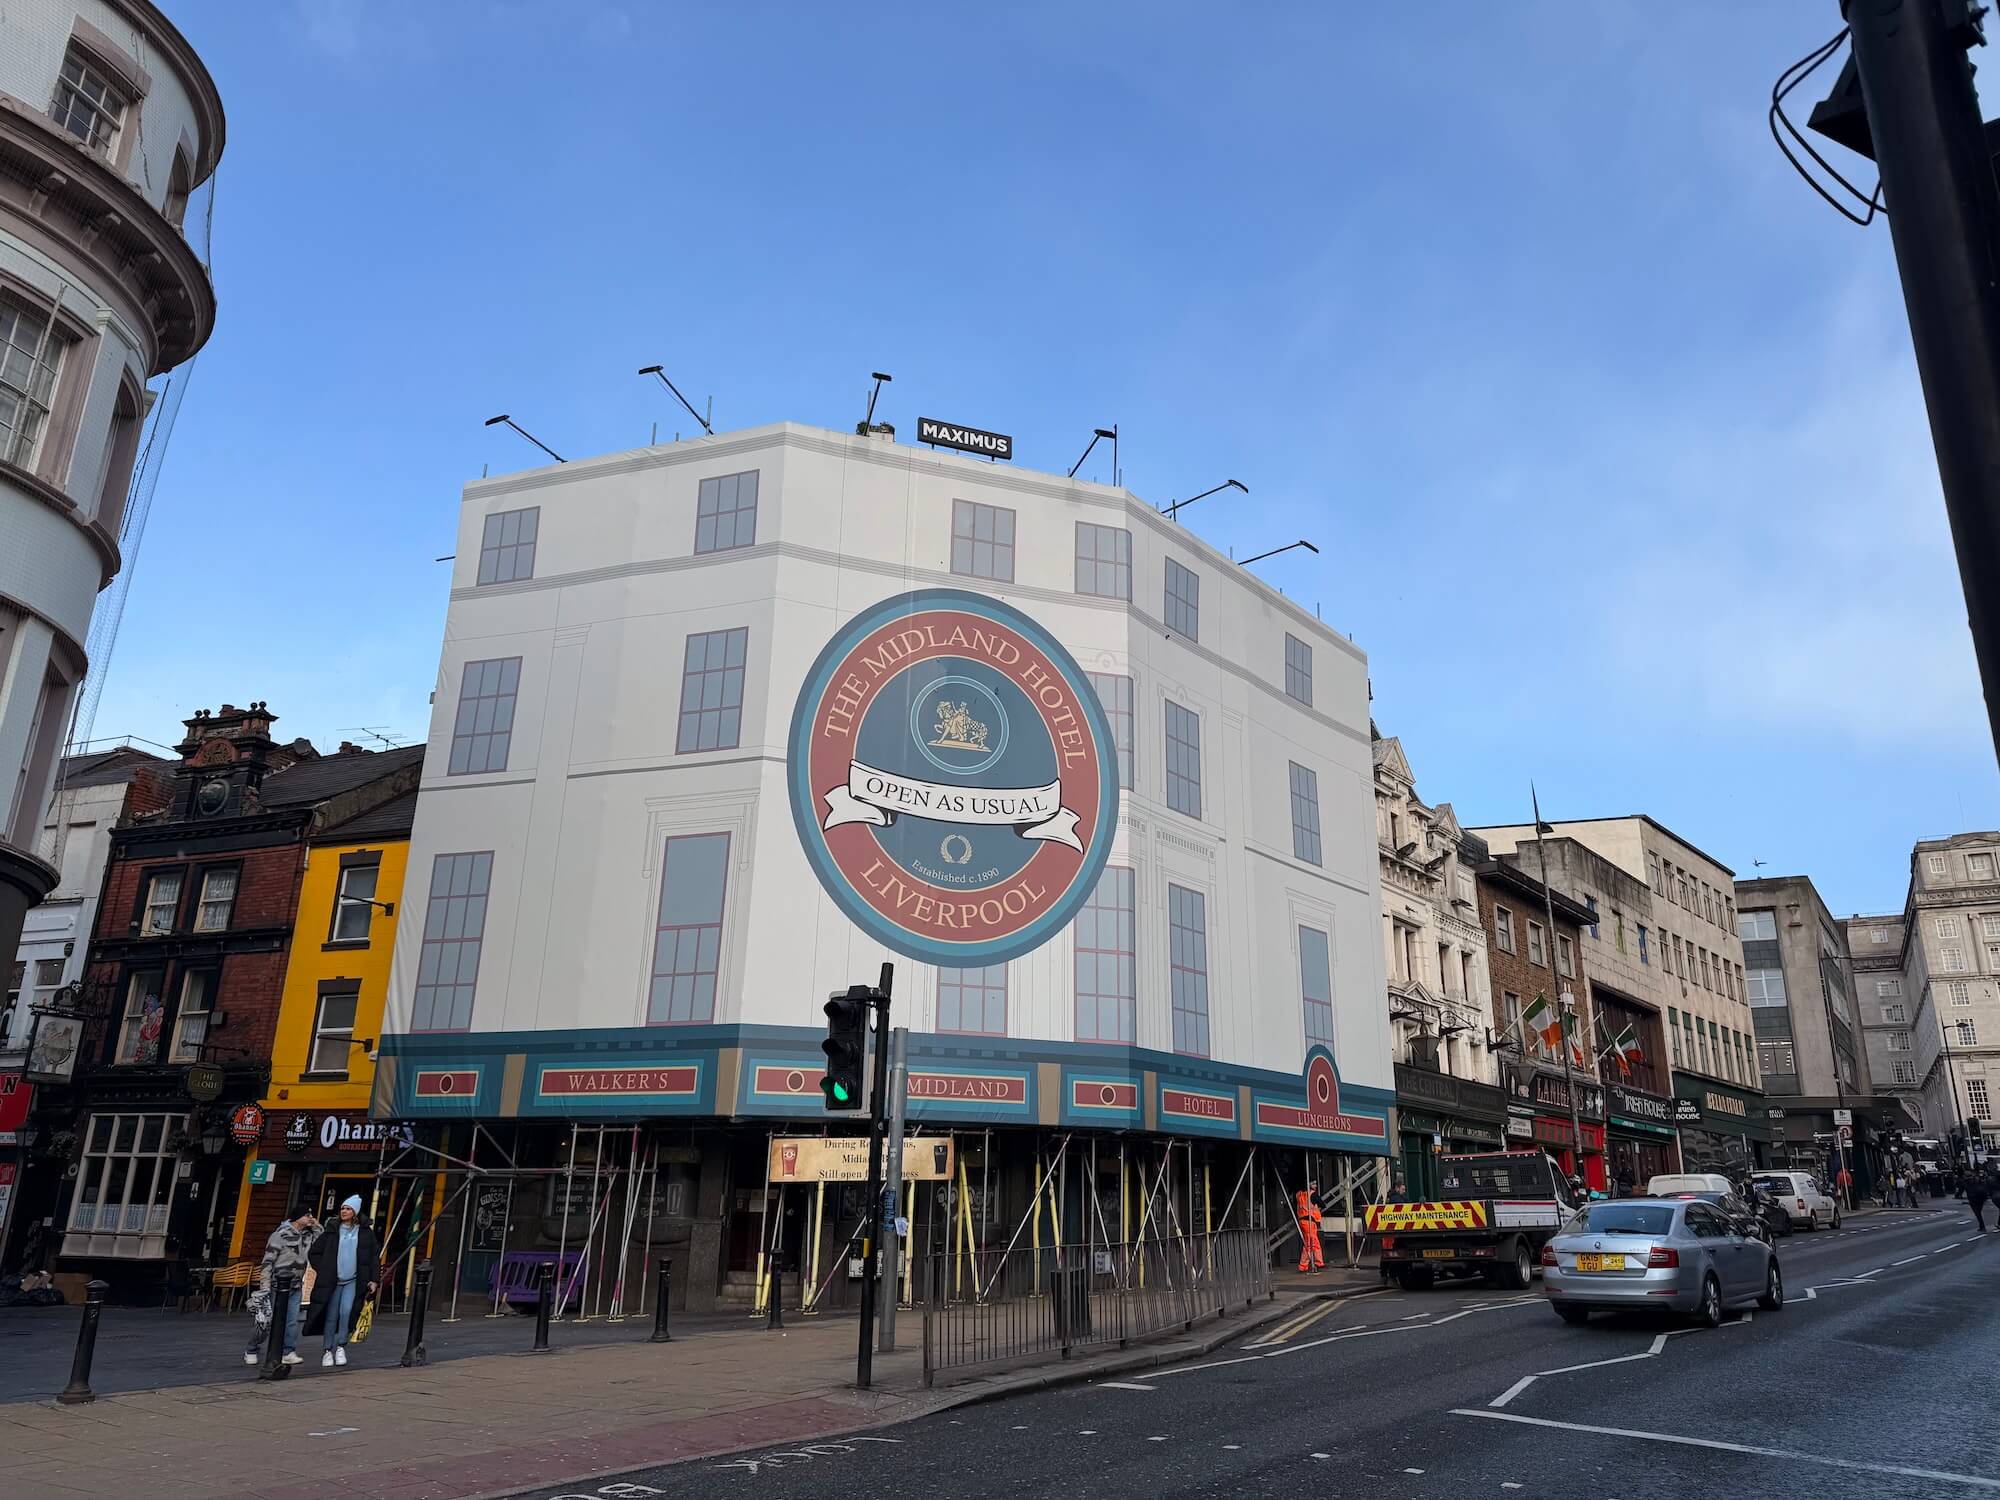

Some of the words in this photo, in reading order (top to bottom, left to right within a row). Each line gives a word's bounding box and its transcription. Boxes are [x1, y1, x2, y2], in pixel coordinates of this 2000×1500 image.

[922, 422, 1008, 452] MAXIMUS
[824, 673, 870, 740] THE
[861, 625, 1021, 678] MIDLAND
[1019, 660, 1087, 770] HOTEL
[866, 776, 931, 807] OPEN
[937, 794, 964, 813] AS
[971, 795, 1048, 815] USUAL
[911, 859, 966, 884] Established
[968, 866, 1000, 884] c.1890
[859, 857, 1047, 928] LIVERPOOL
[567, 1072, 669, 1090] WALKER'S
[906, 1078, 1009, 1098] MIDLAND
[1183, 1096, 1220, 1116] HOTEL
[1297, 1111, 1352, 1131] LUNCHEONS
[824, 1140, 856, 1150] During
[842, 1154, 870, 1164] Midla
[819, 1170, 838, 1178] Still
[840, 1171, 863, 1180] open
[1380, 1212, 1414, 1221] HIGHWAY
[1415, 1210, 1469, 1220] MAINTENANCE
